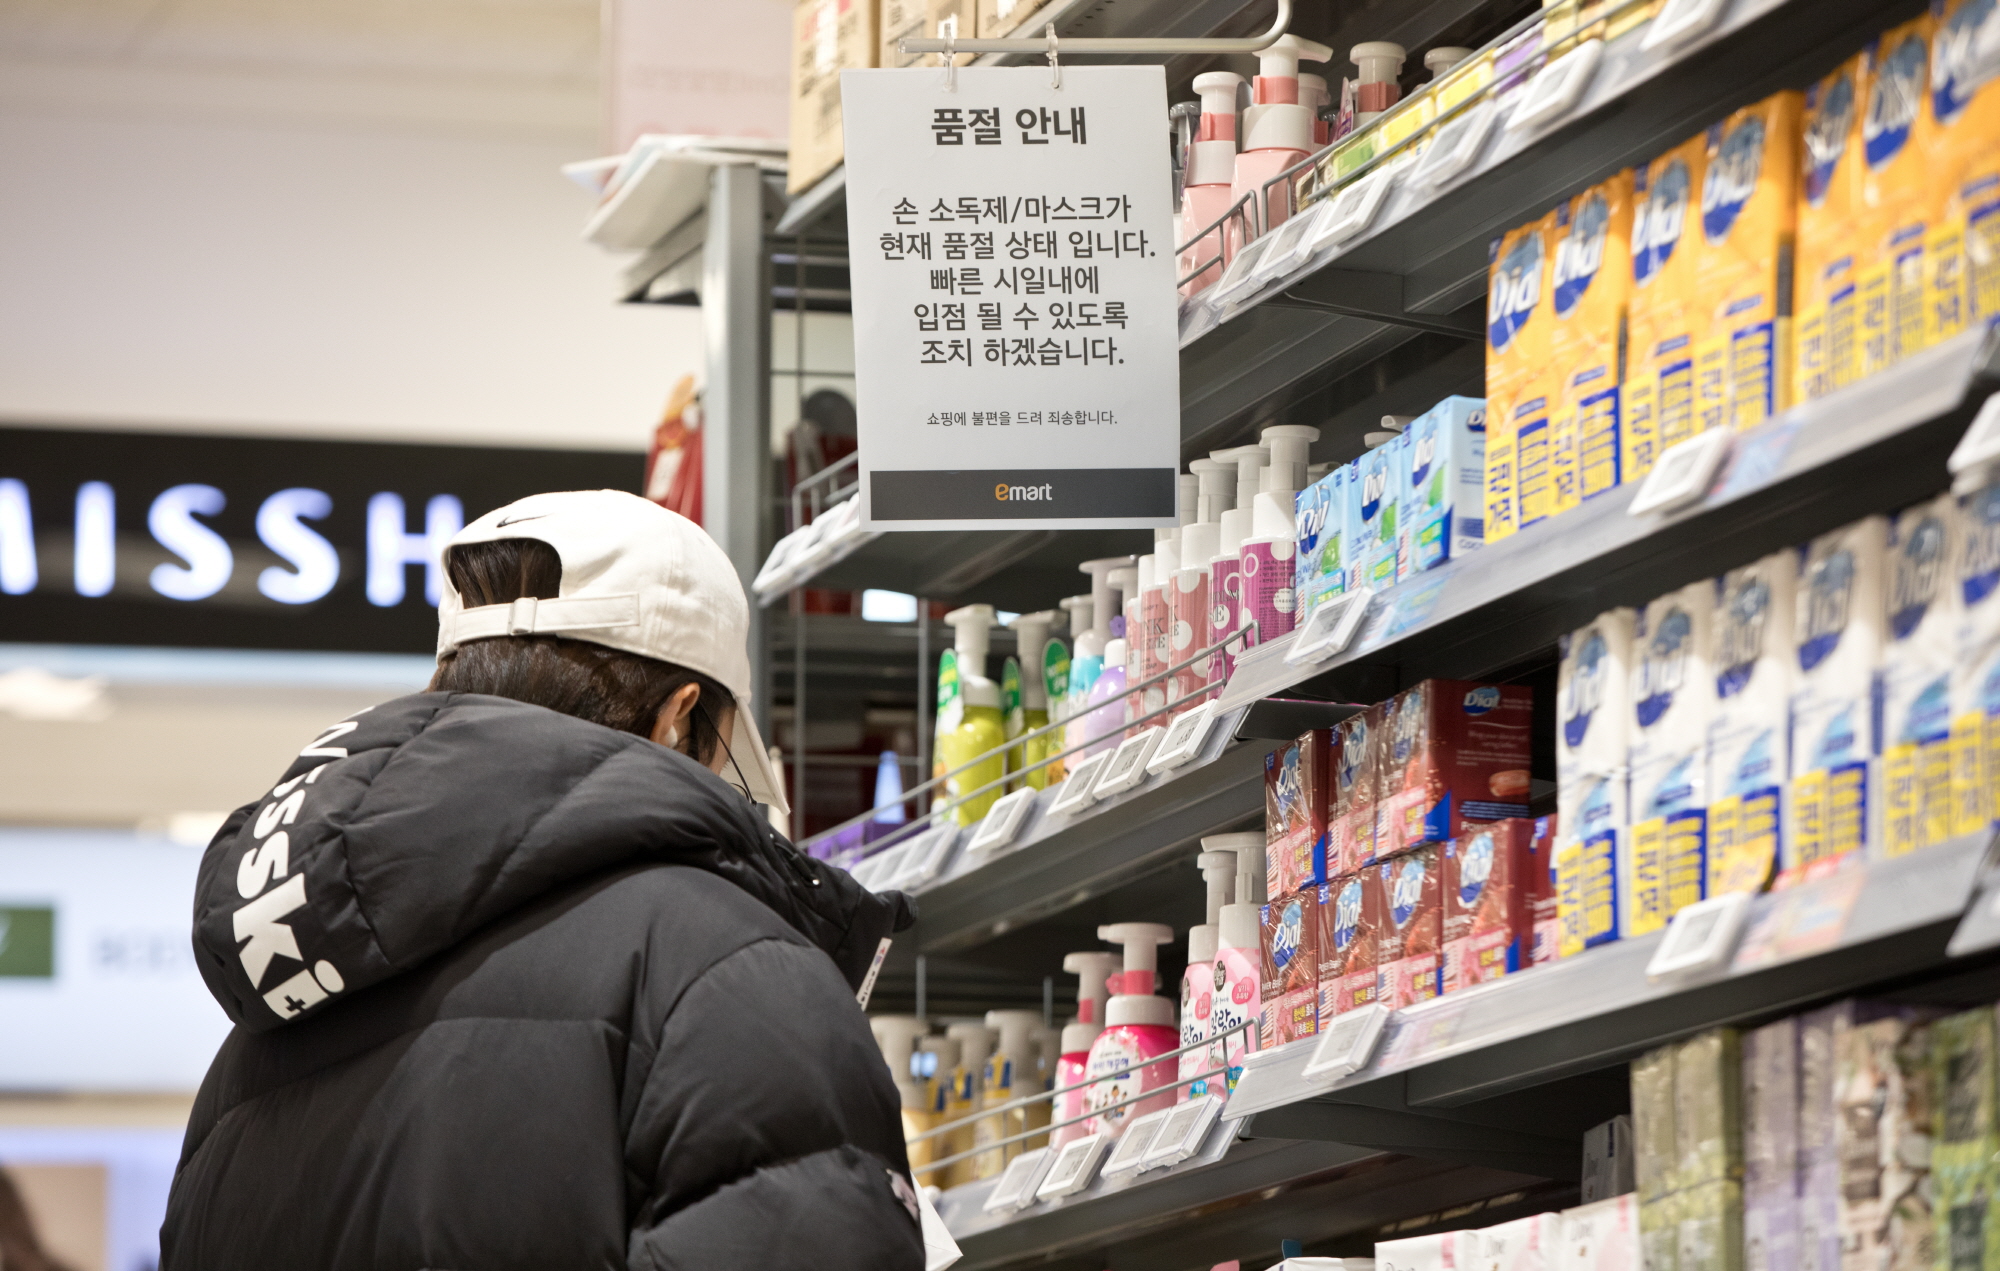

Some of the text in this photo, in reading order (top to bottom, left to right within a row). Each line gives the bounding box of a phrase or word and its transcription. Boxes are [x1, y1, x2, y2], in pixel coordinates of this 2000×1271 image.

[931, 106, 1087, 146] 품절 안내
[892, 194, 1132, 225] 손 소독제/마스크가
[879, 229, 1156, 261] 현재 품절 상태 입니다.
[930, 265, 1099, 296] 빠른 시일내에
[913, 301, 1129, 332] 입점 될 수 있도록
[920, 336, 1125, 367] 조치 하겠습니다.
[926, 410, 1118, 427] 쇼핑에 불편을 드려 죄송합니다.
[994, 482, 1053, 501] emart
[1464, 692, 1500, 708] Dial
